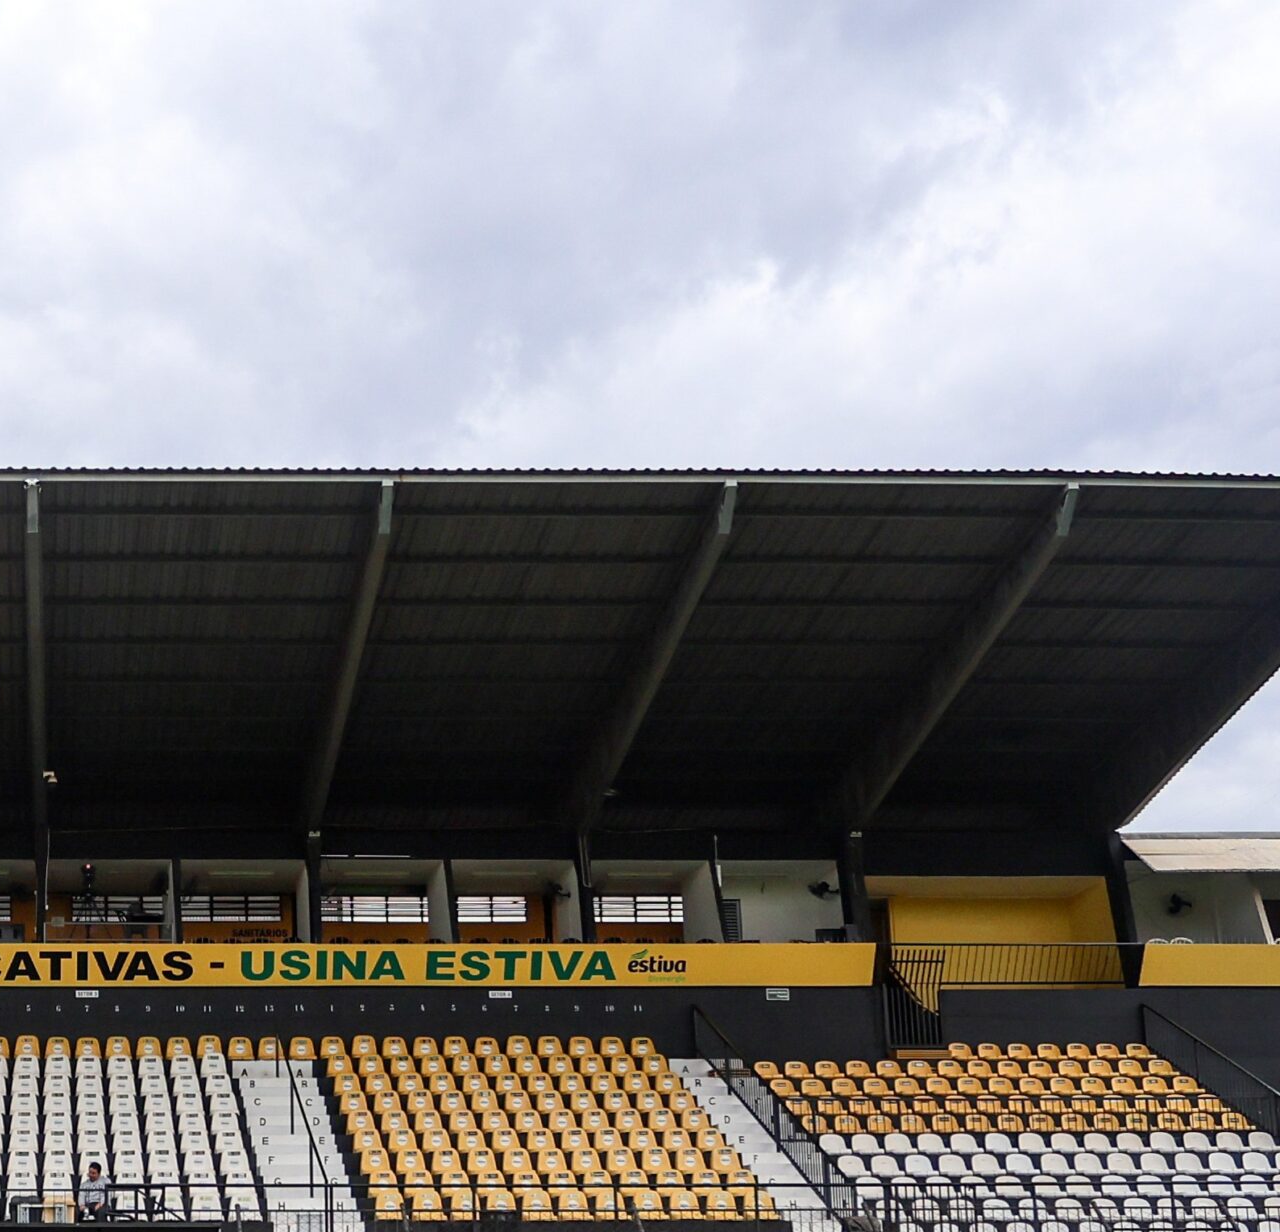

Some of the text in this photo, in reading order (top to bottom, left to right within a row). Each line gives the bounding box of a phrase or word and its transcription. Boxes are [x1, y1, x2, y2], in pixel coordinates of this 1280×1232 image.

[240, 950, 405, 981] USINA
[425, 950, 616, 981] ESTIVA
[628, 955, 686, 973] estiva
[175, 1005, 186, 1013] 10
[203, 1005, 212, 1013] 11
[235, 1005, 245, 1013] 12
[264, 1004, 275, 1013] 13
[294, 1004, 305, 1012] 14
[633, 1004, 643, 1012] 11
